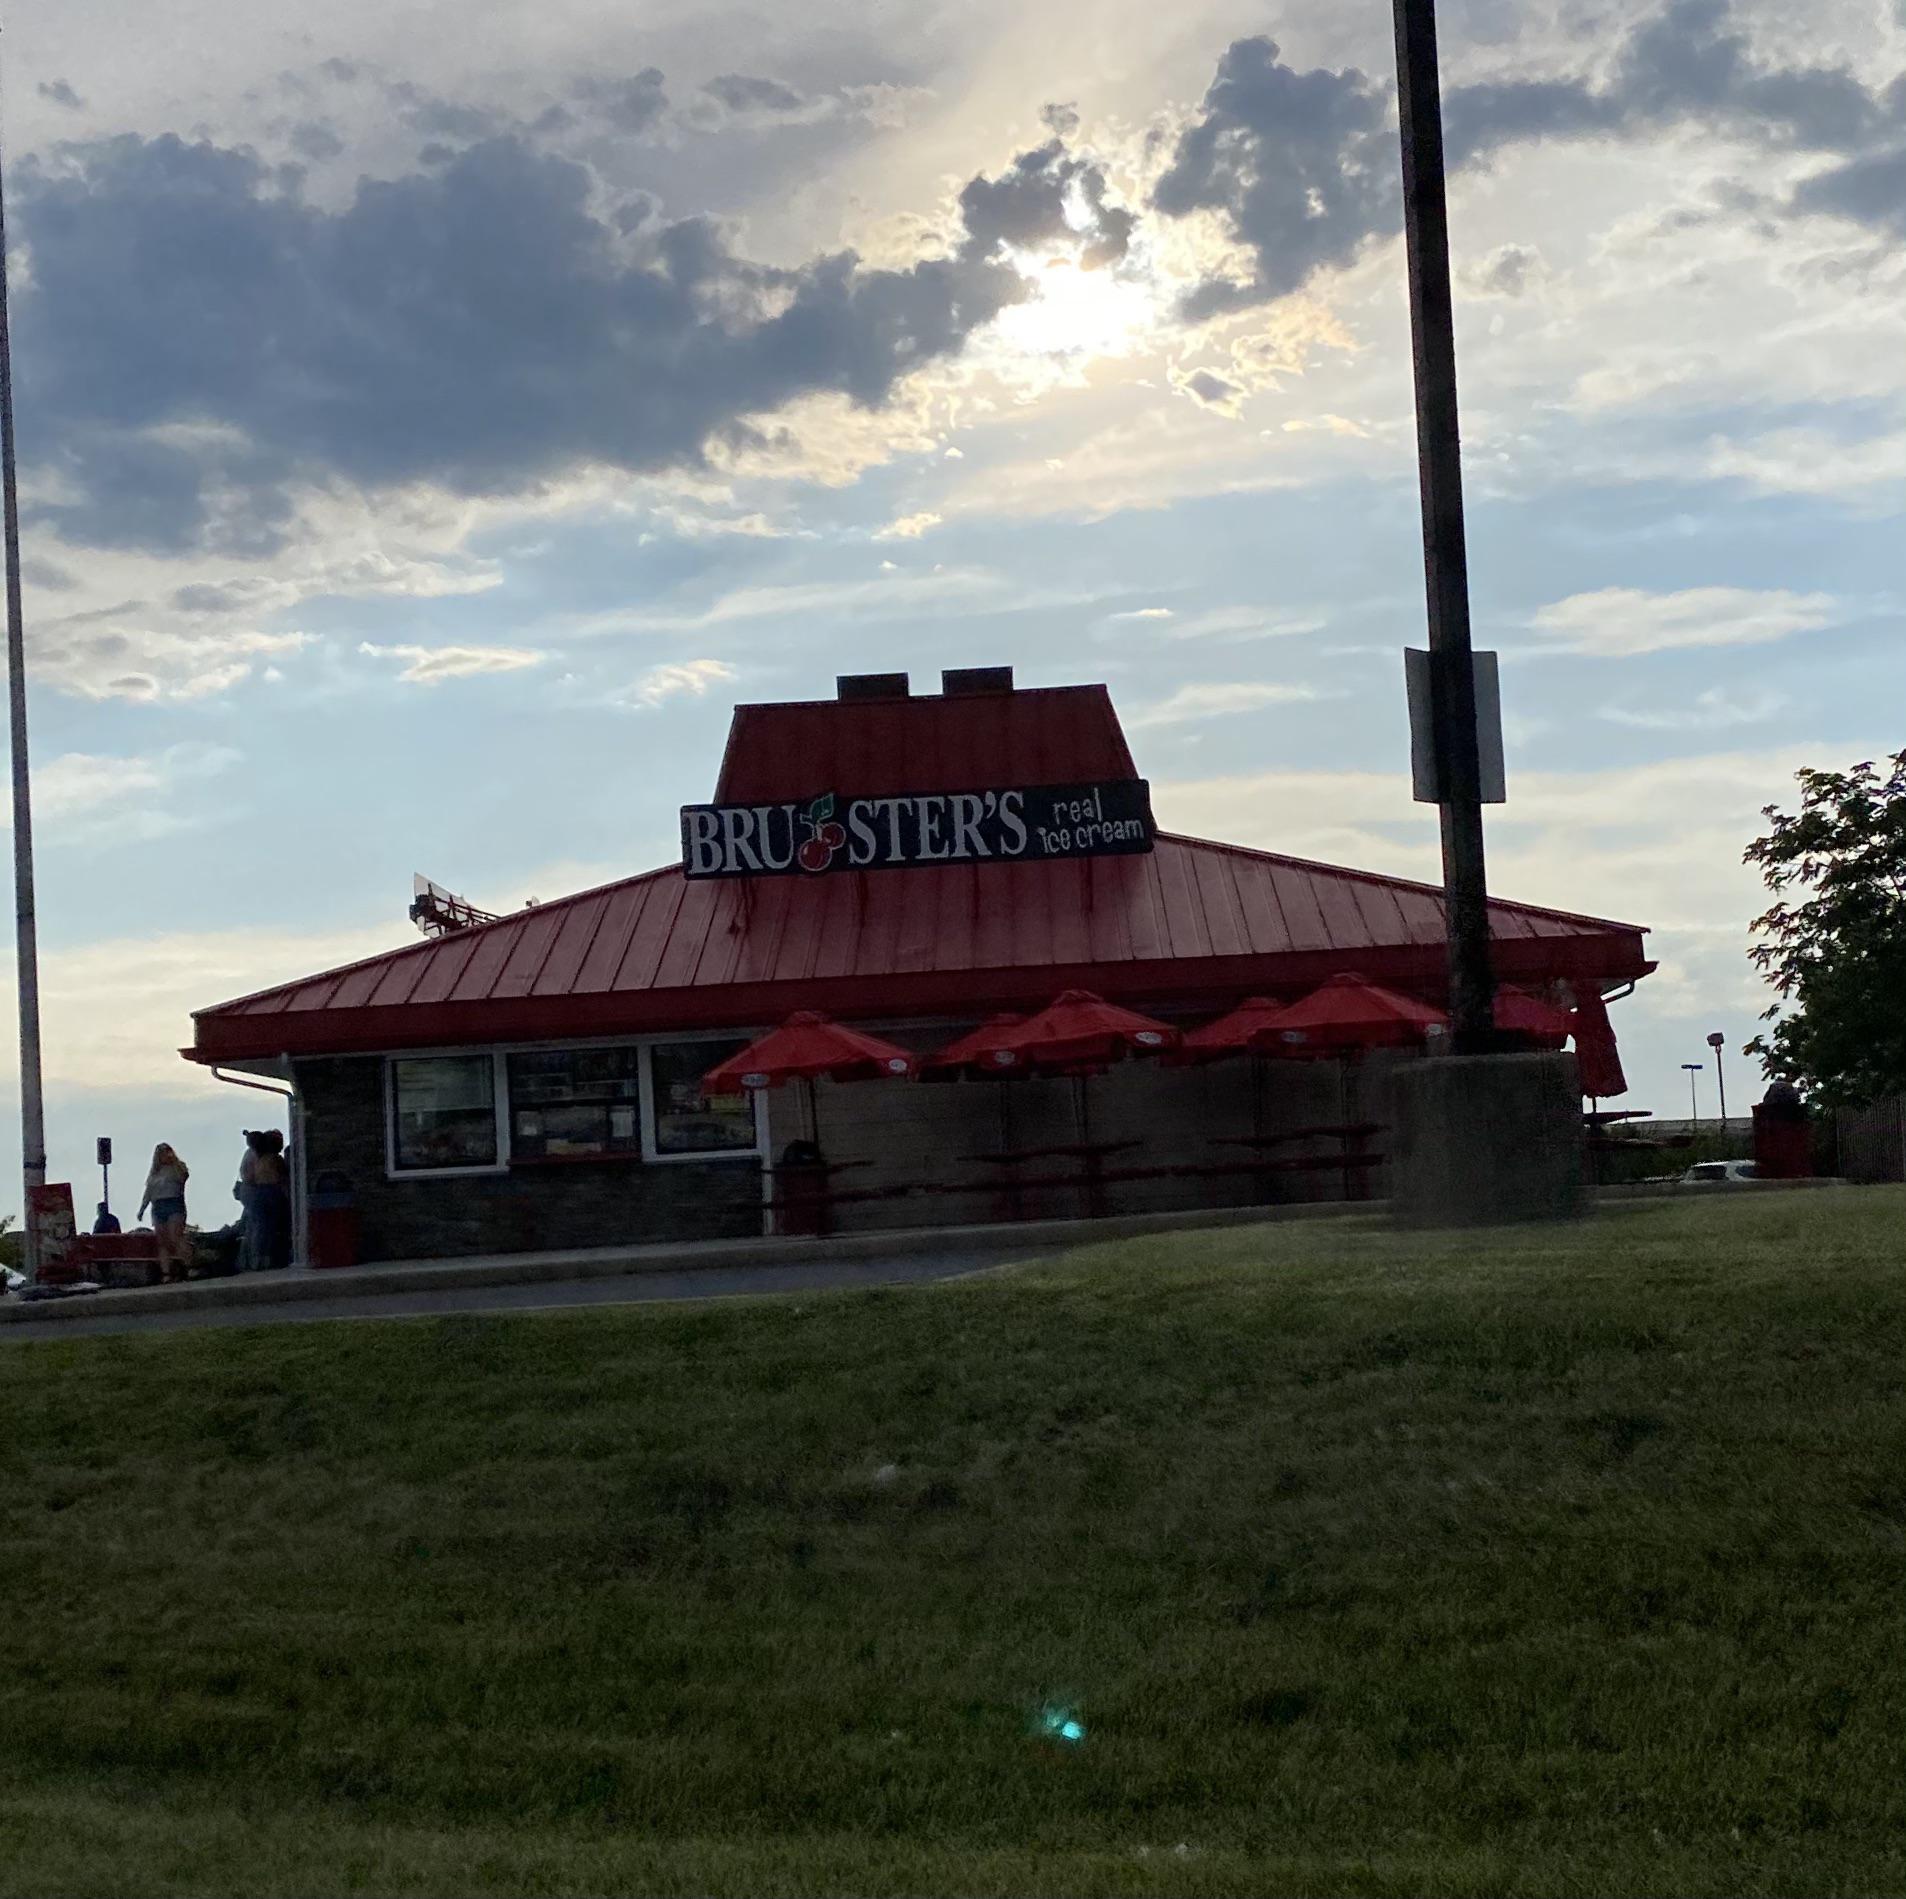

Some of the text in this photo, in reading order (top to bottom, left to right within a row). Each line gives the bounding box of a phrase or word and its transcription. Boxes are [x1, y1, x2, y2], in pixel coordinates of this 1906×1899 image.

[1053, 788, 1102, 824] real
[1038, 819, 1144, 853] ice cream
